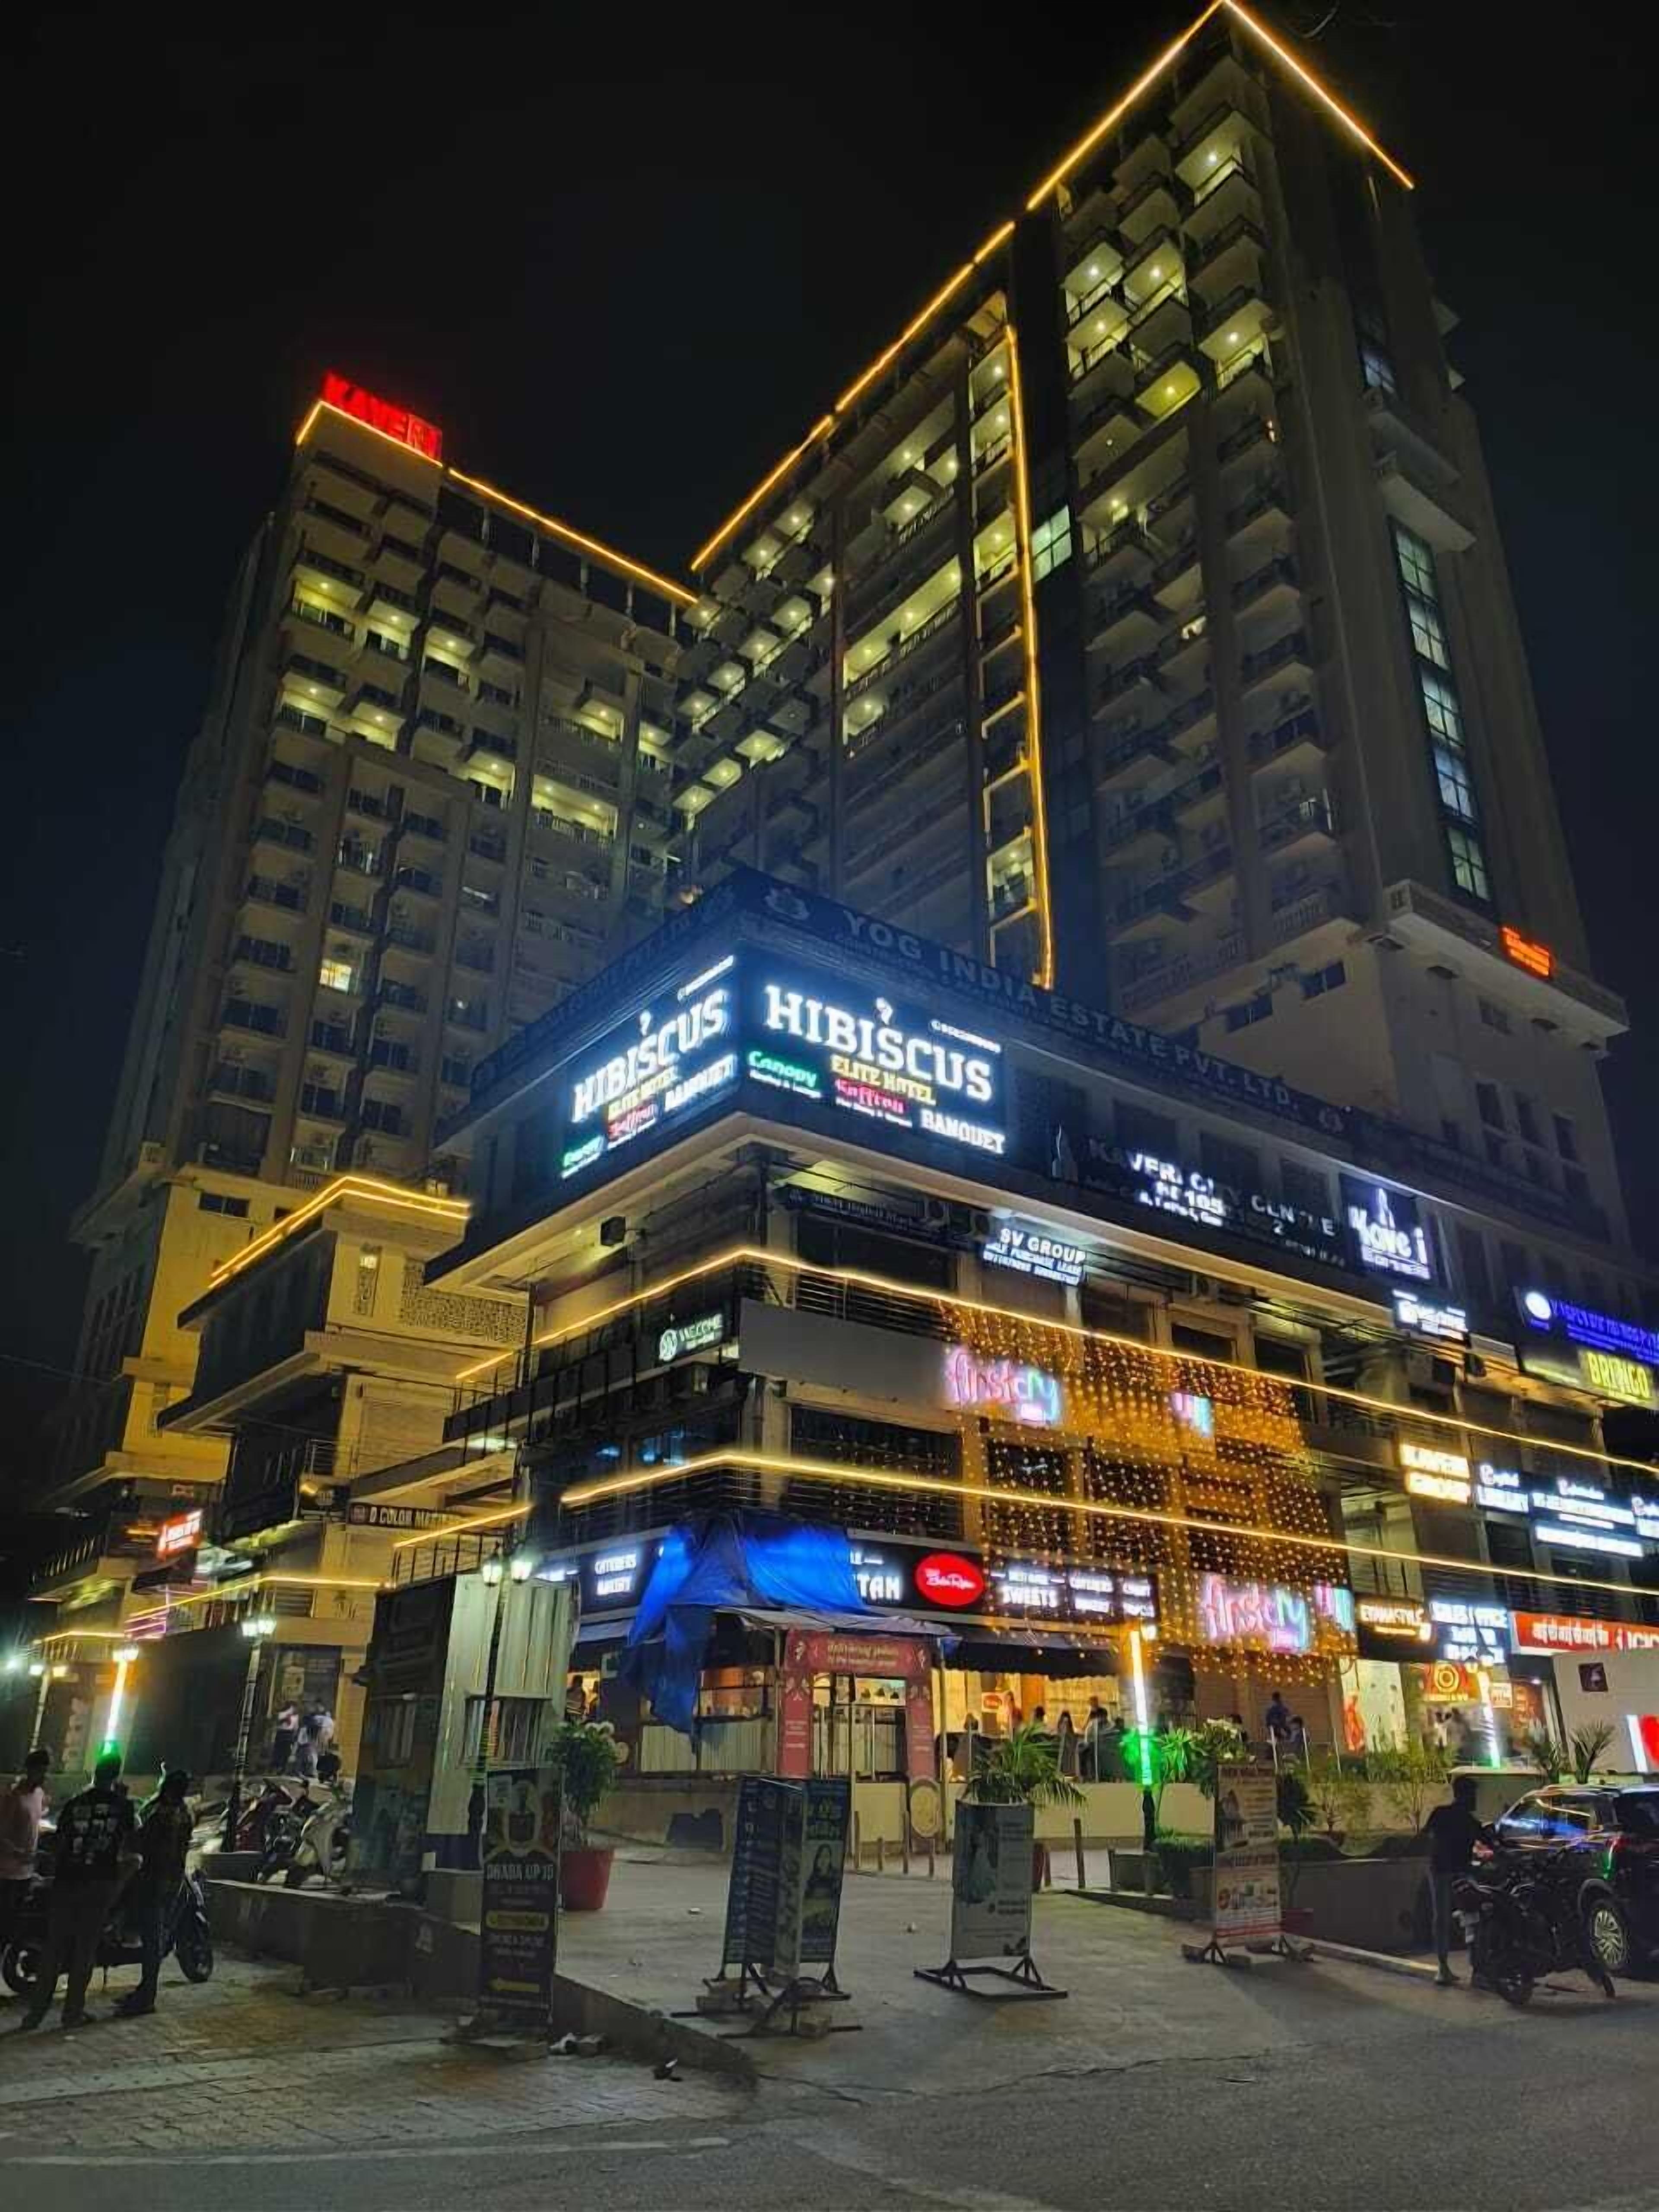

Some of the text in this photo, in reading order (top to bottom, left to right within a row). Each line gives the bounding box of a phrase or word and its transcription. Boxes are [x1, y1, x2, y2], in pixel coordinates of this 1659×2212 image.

[844, 909, 923, 959] YOG
[940, 950, 1036, 1003] INDIA
[1051, 996, 1166, 1057] ESTATE
[572, 989, 730, 1123] HIBISCUS
[765, 984, 993, 1102] HIBISCUS
[749, 1050, 817, 1087] Canopy
[830, 1054, 881, 1085] ELITE
[883, 1071, 936, 1106] HOTEL
[921, 1109, 1006, 1154] BANQUET
[1000, 1228, 1086, 1264] SV GROUP
[1002, 1585, 1057, 1608] SWEETS
